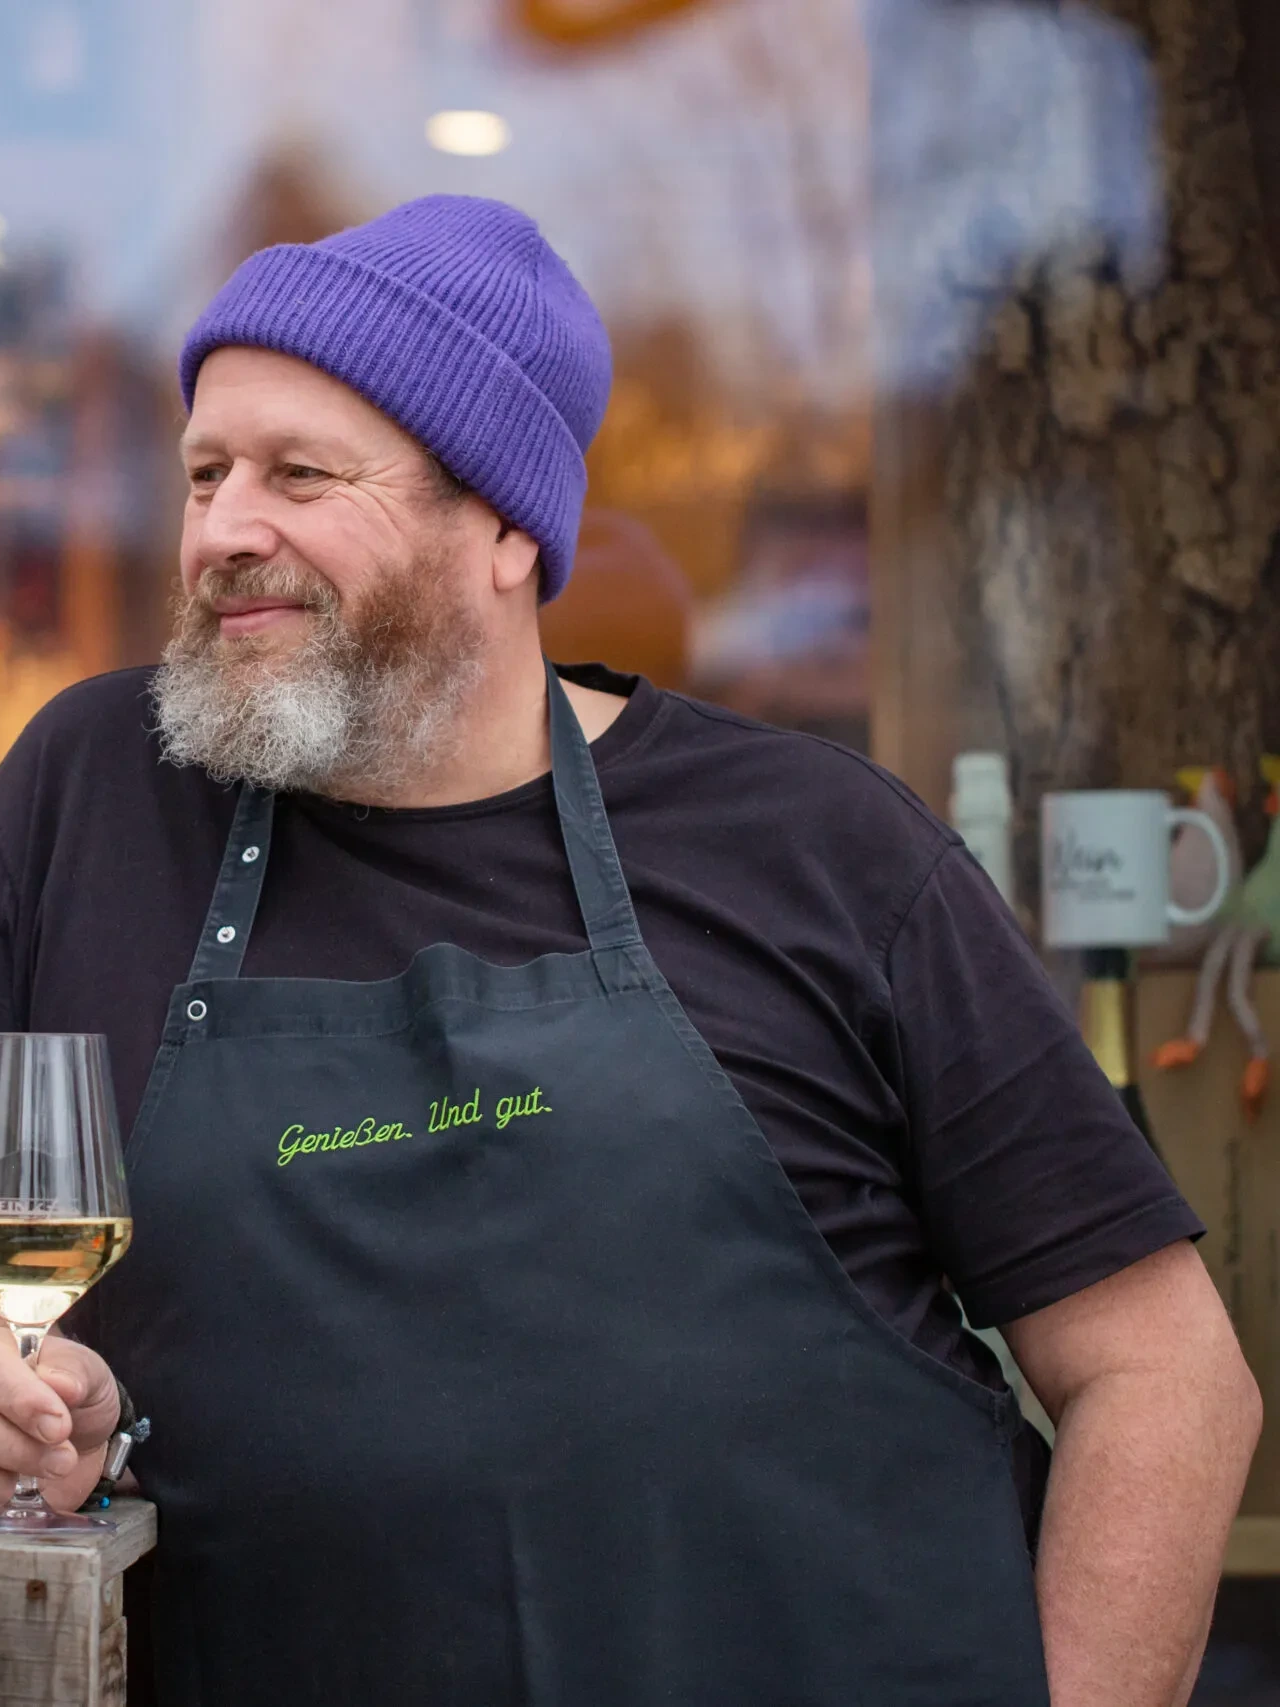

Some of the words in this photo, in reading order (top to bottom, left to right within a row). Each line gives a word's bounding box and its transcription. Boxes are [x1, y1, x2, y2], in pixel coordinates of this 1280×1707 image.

[276, 1117, 413, 1167] Genießen.
[428, 1088, 483, 1133] Und
[496, 1086, 553, 1130] gut.
